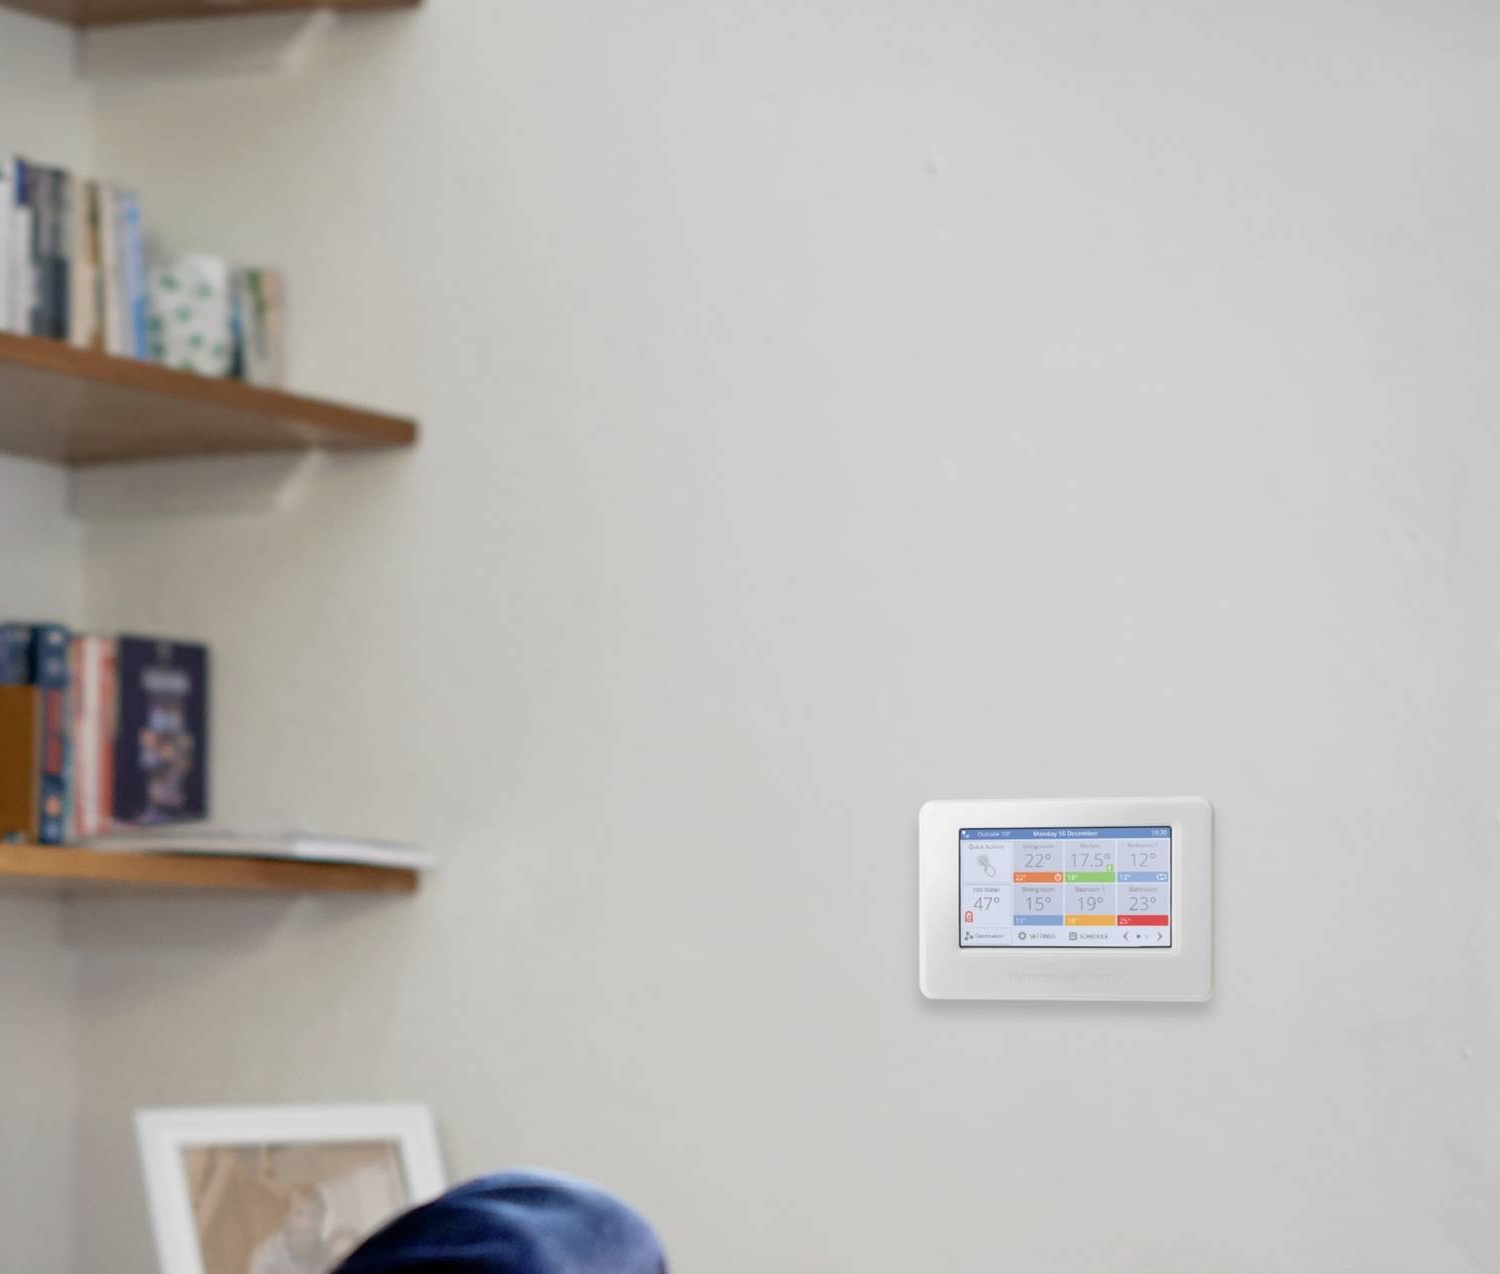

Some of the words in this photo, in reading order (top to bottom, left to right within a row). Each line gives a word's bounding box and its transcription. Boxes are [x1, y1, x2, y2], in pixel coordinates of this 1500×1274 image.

[1025, 853, 1051, 868] 22°
[1071, 853, 1111, 868] 17.5°
[1131, 853, 1157, 868] 12°
[973, 897, 1000, 911] 47°
[1026, 897, 1052, 911] 15°
[1078, 896, 1104, 911] 19°
[1129, 896, 1157, 911] 23°
